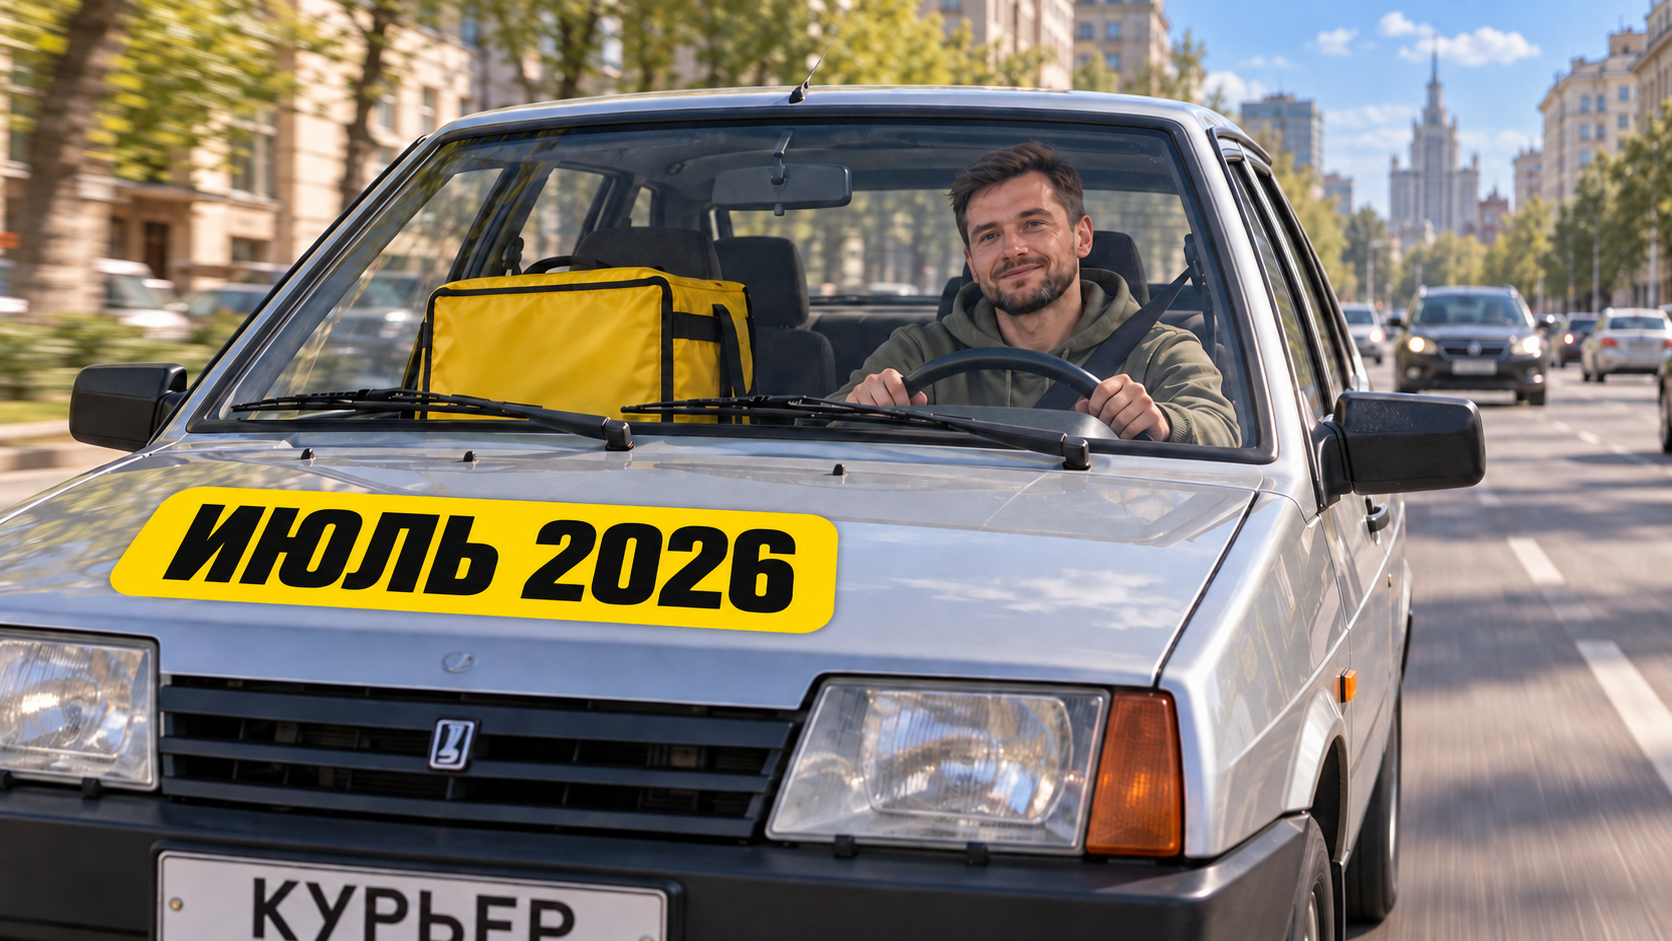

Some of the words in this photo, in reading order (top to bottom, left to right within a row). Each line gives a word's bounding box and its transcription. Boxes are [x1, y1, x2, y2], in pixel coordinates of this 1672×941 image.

[163, 504, 499, 595] ИЮЛЬ
[521, 520, 796, 614] 2026
[252, 877, 576, 941] КУРЬЕР
